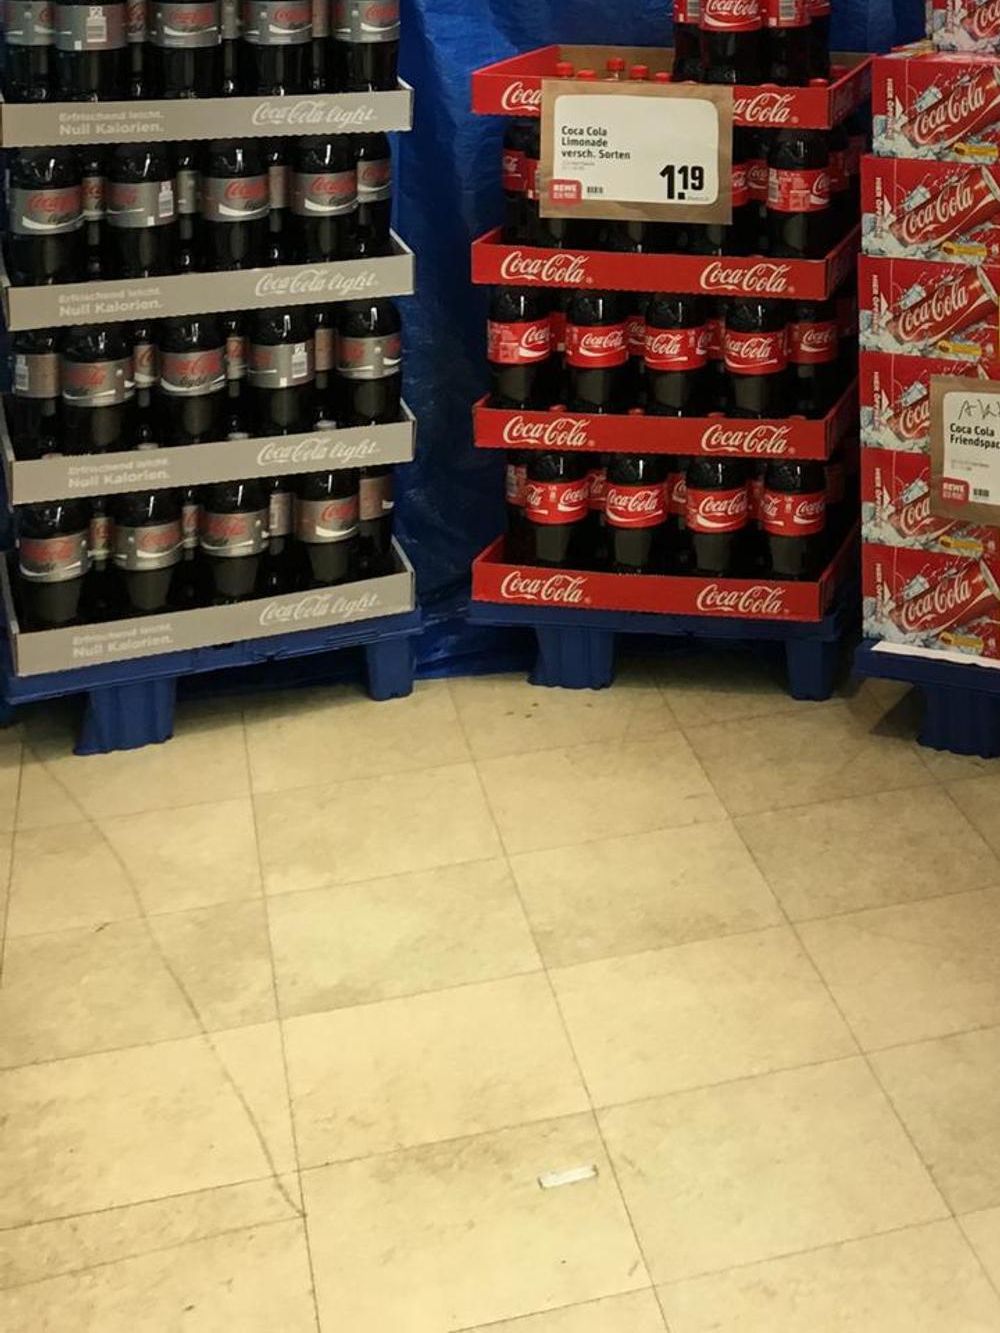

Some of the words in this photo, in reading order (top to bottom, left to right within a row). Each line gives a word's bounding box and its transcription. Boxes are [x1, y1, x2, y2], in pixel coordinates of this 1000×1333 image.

[733, 93, 791, 124] a-Cola
[60, 124, 91, 135] Null
[562, 126, 584, 135] Coca
[587, 127, 607, 136] Cola
[562, 137, 608, 147] Limonade
[562, 149, 595, 159] versch.
[599, 150, 630, 159] Sorten
[59, 303, 92, 316] Null
[950, 423, 972, 434] Coca
[974, 426, 994, 436] Cola
[69, 475, 98, 487] Null
[73, 646, 103, 658] Null
